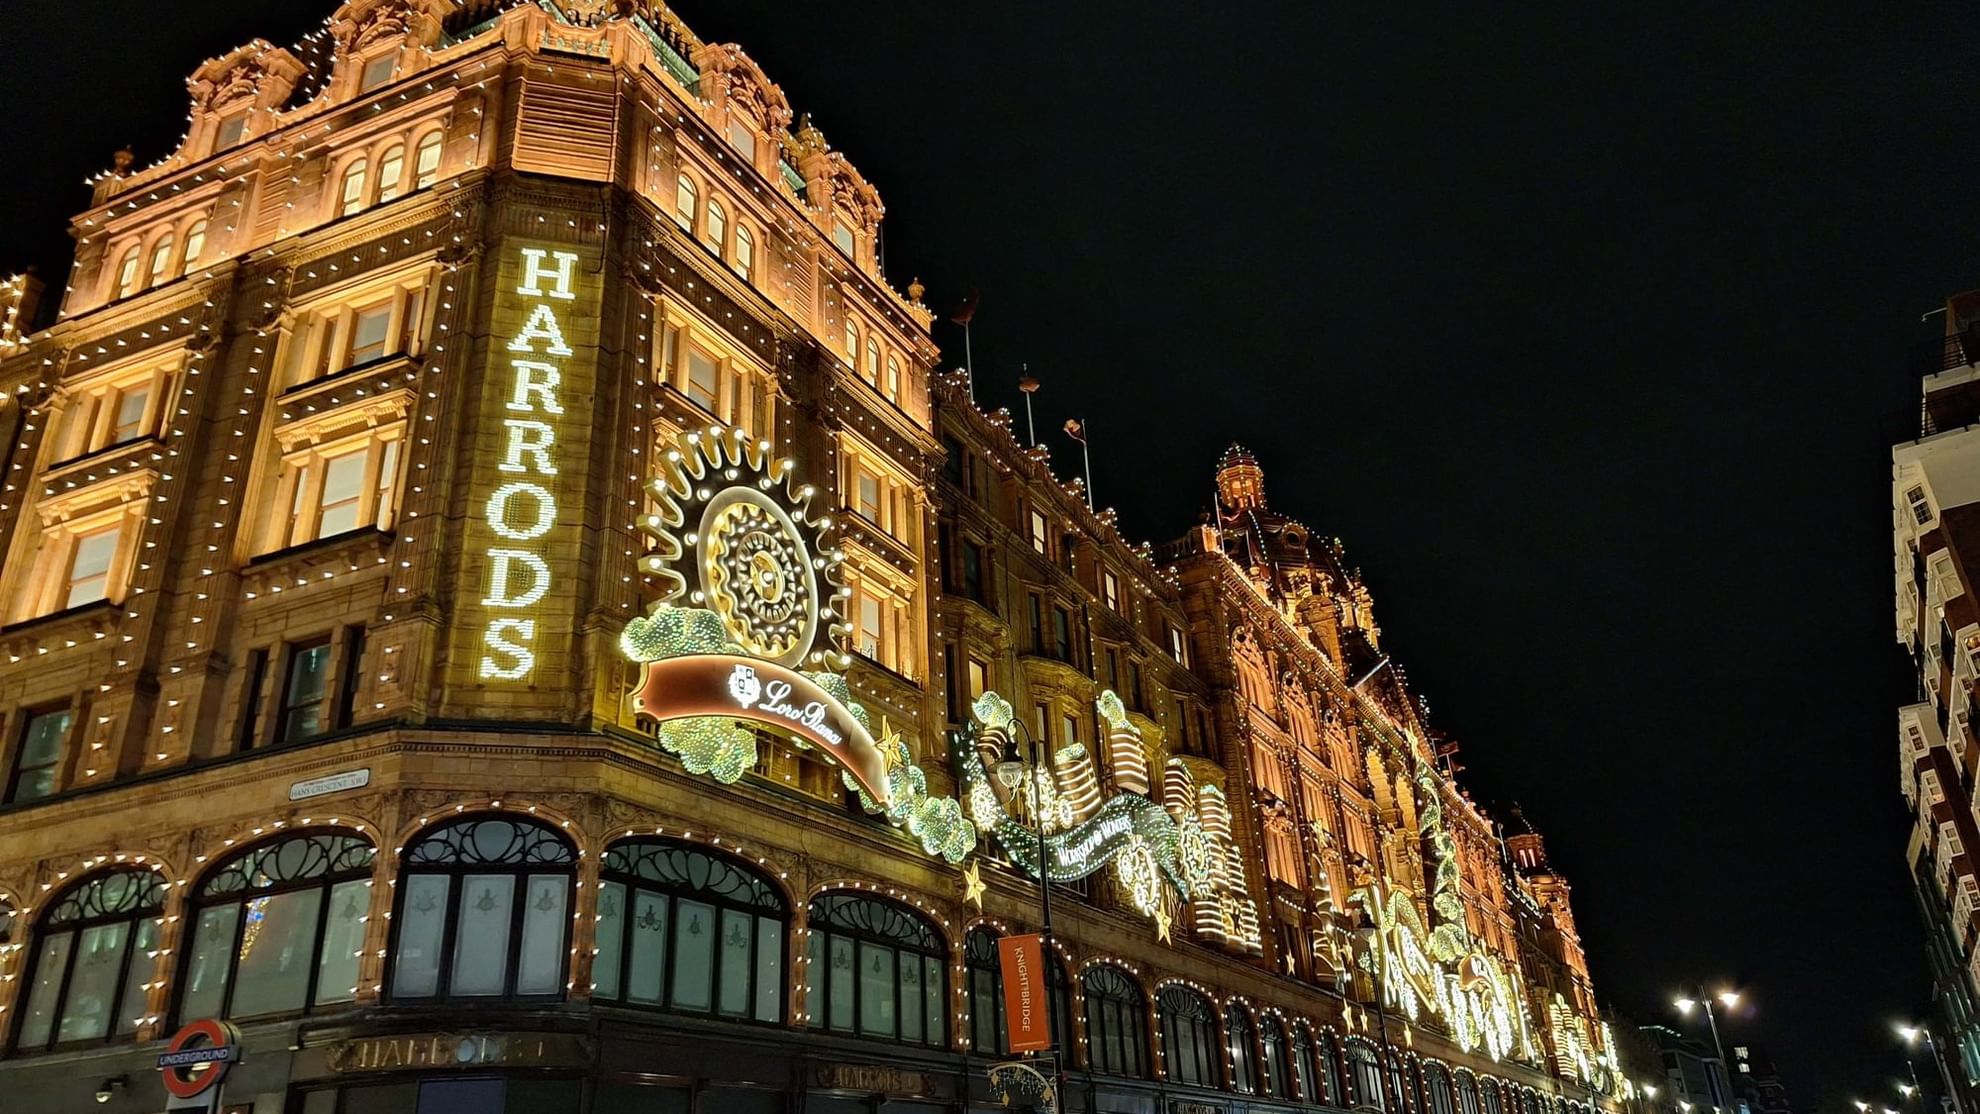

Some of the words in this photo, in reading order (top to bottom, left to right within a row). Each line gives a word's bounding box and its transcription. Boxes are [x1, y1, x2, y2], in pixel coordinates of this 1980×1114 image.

[480, 247, 579, 680] HARRODS
[758, 680, 804, 720] Loro
[801, 701, 842, 745] Piana
[310, 780, 347, 794] CRESCENT
[160, 1049, 228, 1065] UNDERGROUND
